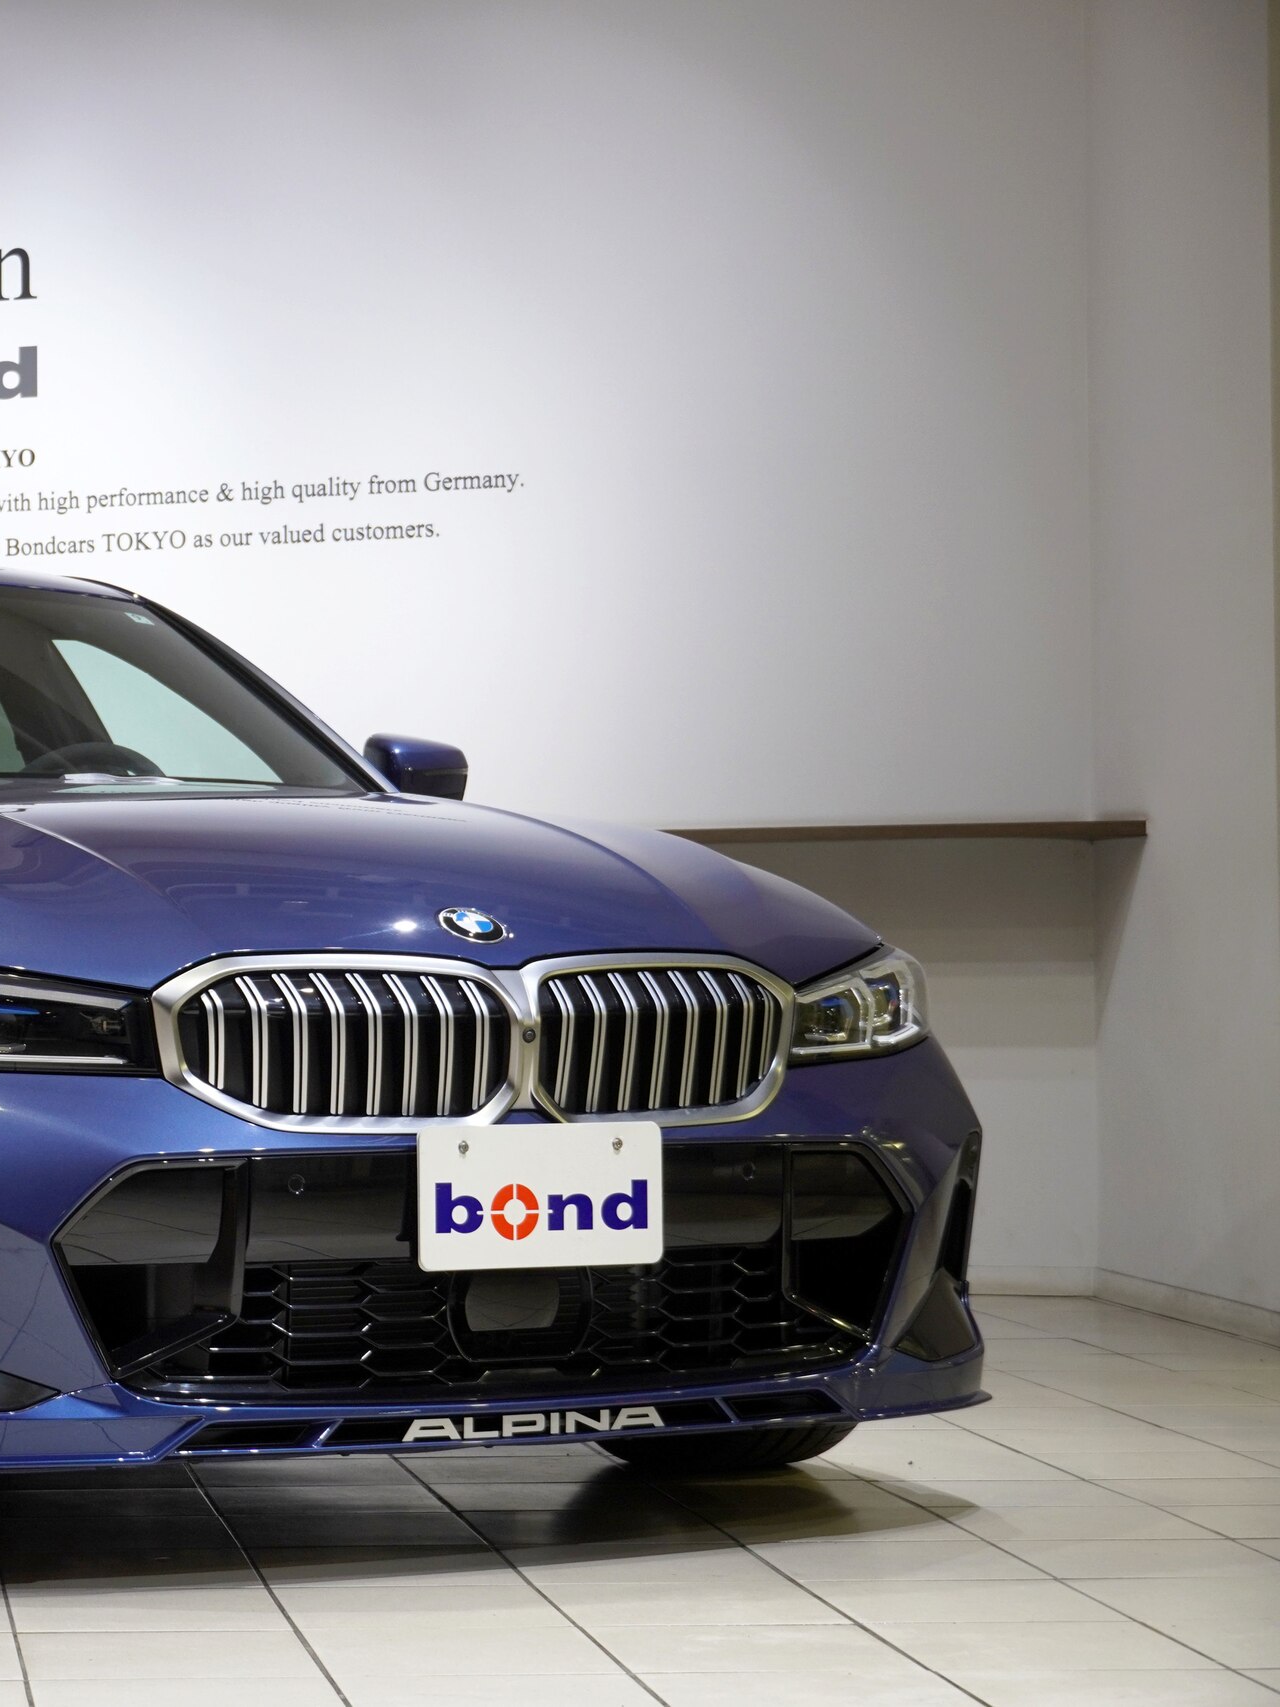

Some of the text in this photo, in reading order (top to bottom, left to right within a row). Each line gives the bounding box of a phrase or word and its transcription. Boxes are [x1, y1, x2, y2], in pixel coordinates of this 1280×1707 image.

[37, 489, 80, 516] high
[85, 486, 210, 515] performance
[216, 482, 235, 503] &
[241, 479, 286, 506] high
[291, 476, 362, 504] quality
[368, 474, 418, 495] from
[424, 471, 525, 495] Germany.
[5, 536, 96, 557] Bondcars
[101, 529, 187, 553] TOKYO
[193, 534, 214, 549] as
[219, 531, 254, 548] our
[259, 522, 326, 545] valued
[331, 523, 441, 543] customers.
[434, 1178, 649, 1241] bond
[401, 1405, 665, 1442] ALPINA
